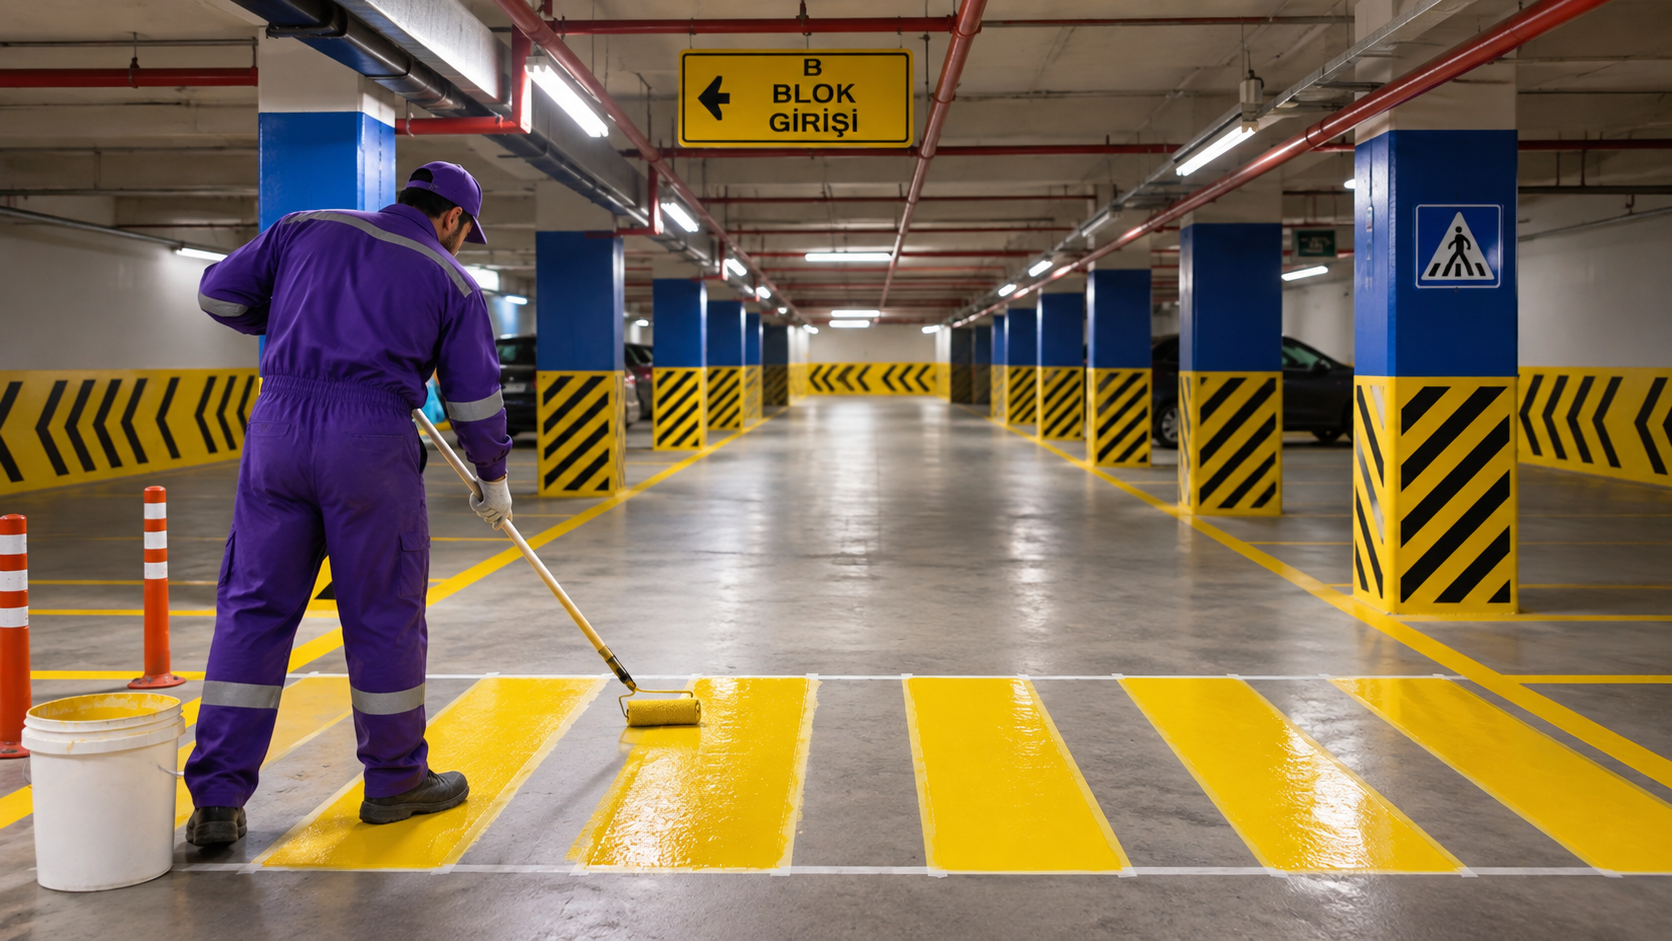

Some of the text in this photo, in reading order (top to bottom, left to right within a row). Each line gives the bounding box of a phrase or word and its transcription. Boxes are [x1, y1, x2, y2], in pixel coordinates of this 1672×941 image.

[803, 59, 822, 76] B
[773, 84, 856, 103] BLOK
[769, 108, 858, 137] GİRİŞİ
